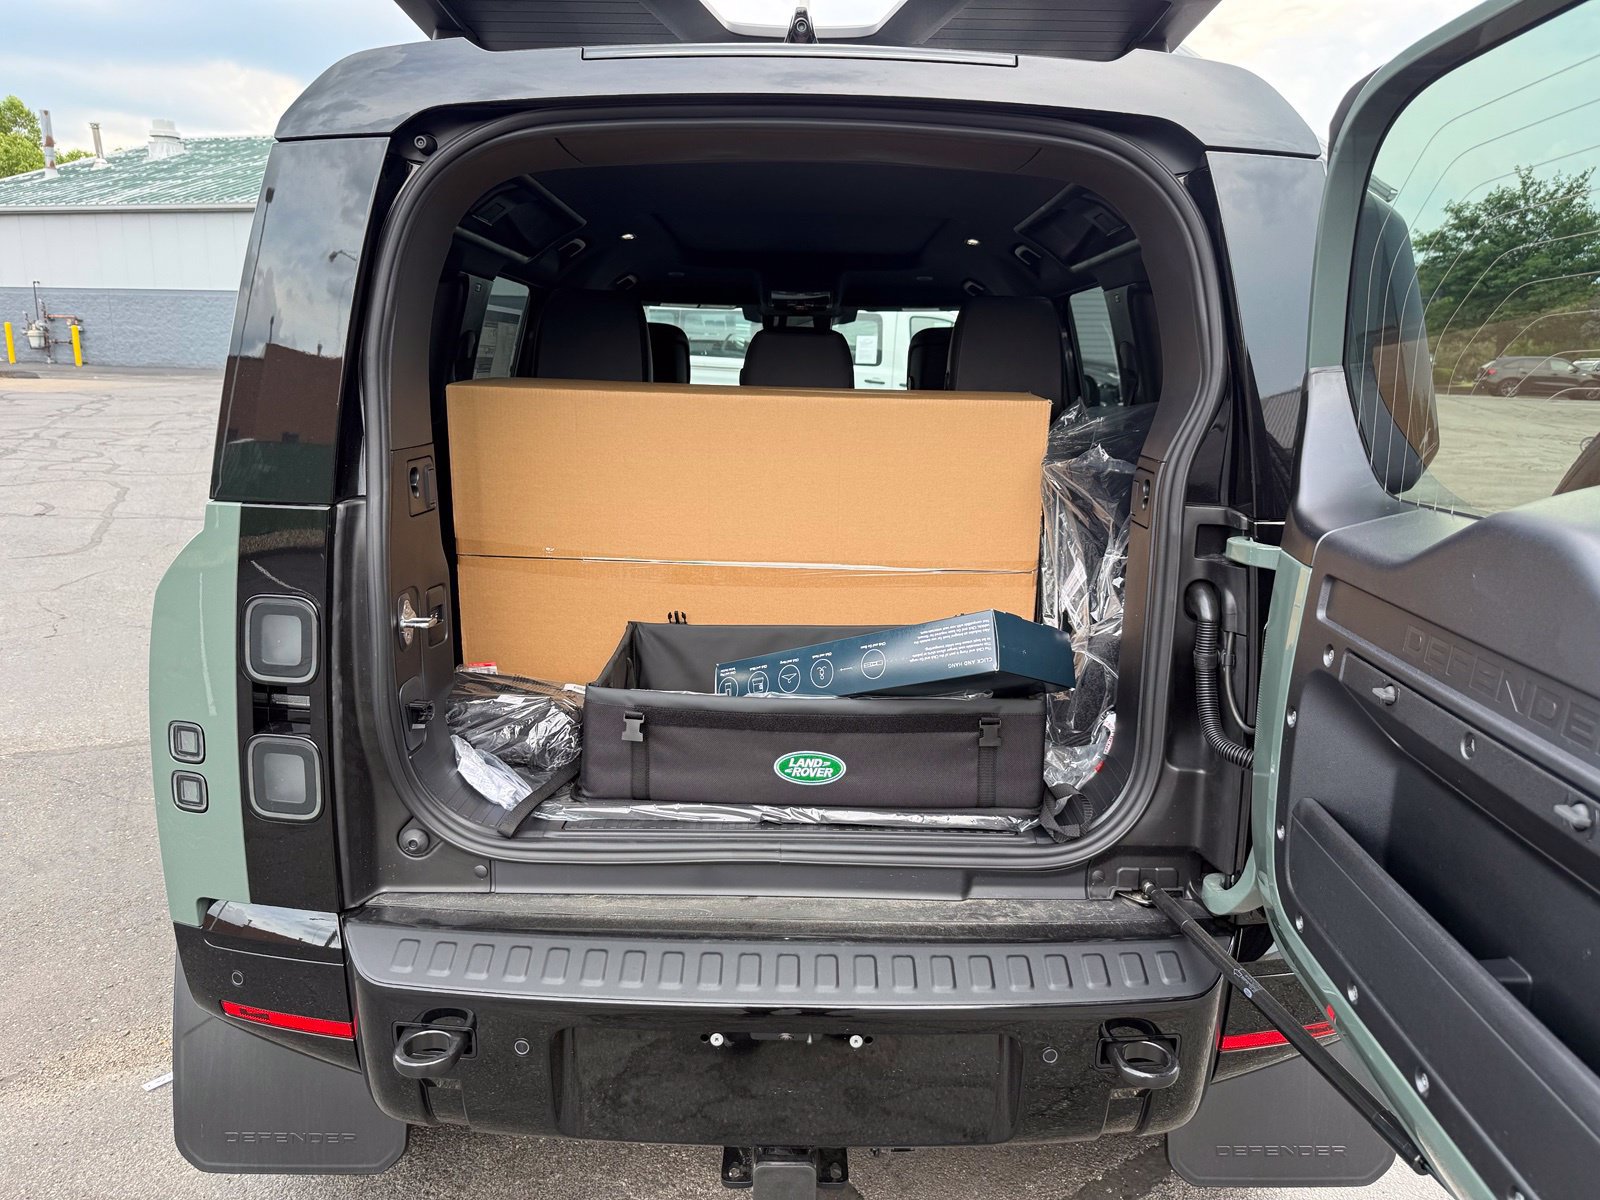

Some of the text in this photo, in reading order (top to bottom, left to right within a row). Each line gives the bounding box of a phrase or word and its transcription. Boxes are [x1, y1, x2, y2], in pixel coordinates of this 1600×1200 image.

[977, 656, 993, 664] CLICK
[947, 661, 963, 669] HANG
[1402, 624, 1600, 756] DEFENDE
[789, 758, 822, 767] LAND
[792, 768, 834, 777] ROVER
[224, 1131, 357, 1143] DEFENDER
[1216, 1145, 1347, 1157] DEFENDER
